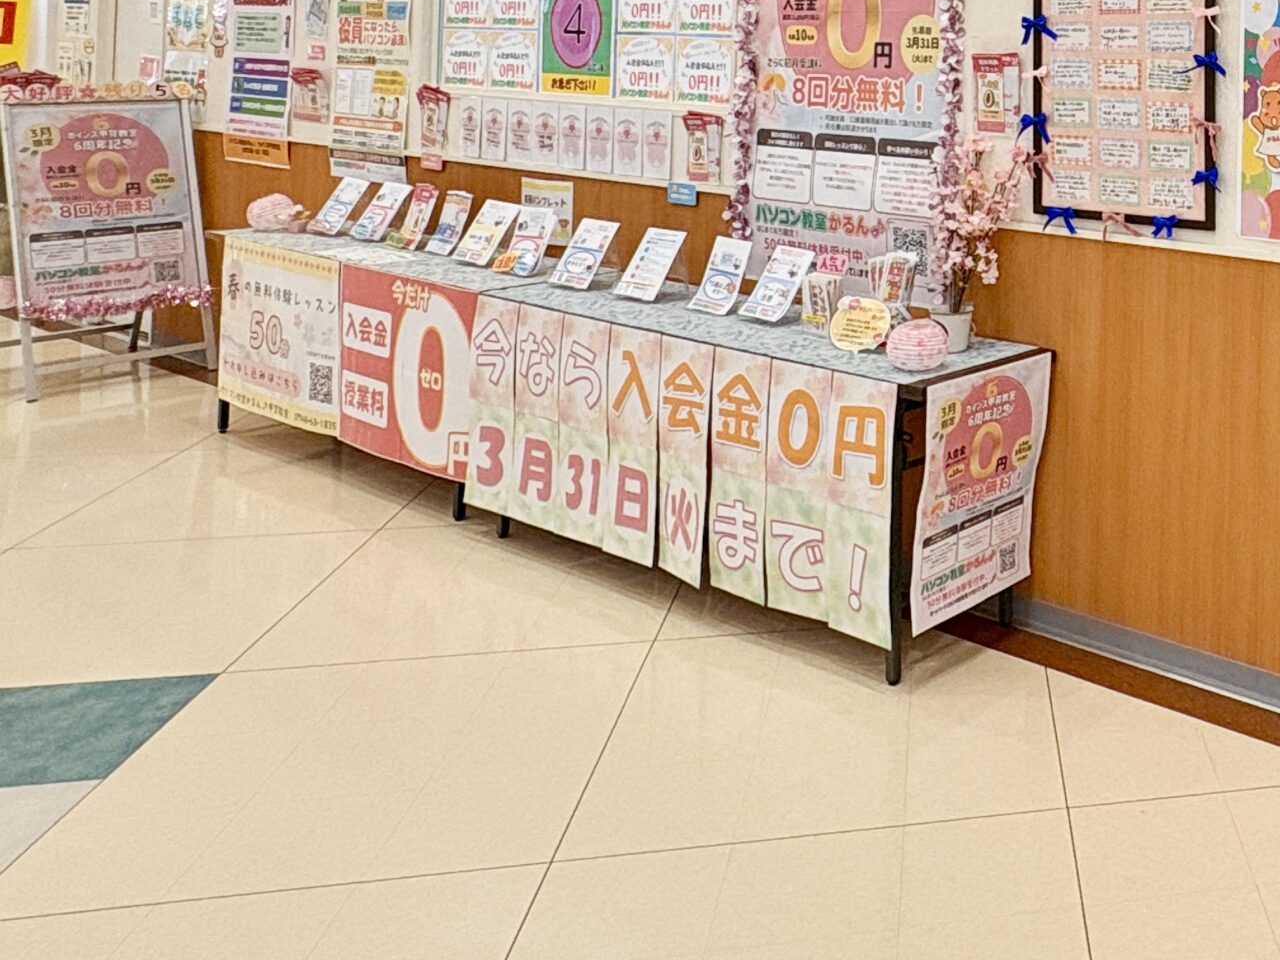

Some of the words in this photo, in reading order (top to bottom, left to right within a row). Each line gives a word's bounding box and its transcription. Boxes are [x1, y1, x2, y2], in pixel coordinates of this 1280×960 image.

[563, 3, 586, 44] 4
[906, 37, 939, 50] 3月31日
[792, 76, 924, 113] 8回分無料!
[227, 272, 336, 315] 春の無料体験レッスン
[391, 279, 431, 311] 今だけ
[345, 312, 388, 348] 入会金
[418, 367, 442, 392] ゼロ
[343, 378, 385, 419] 授業料
[473, 318, 887, 489] 今なら入会金0円
